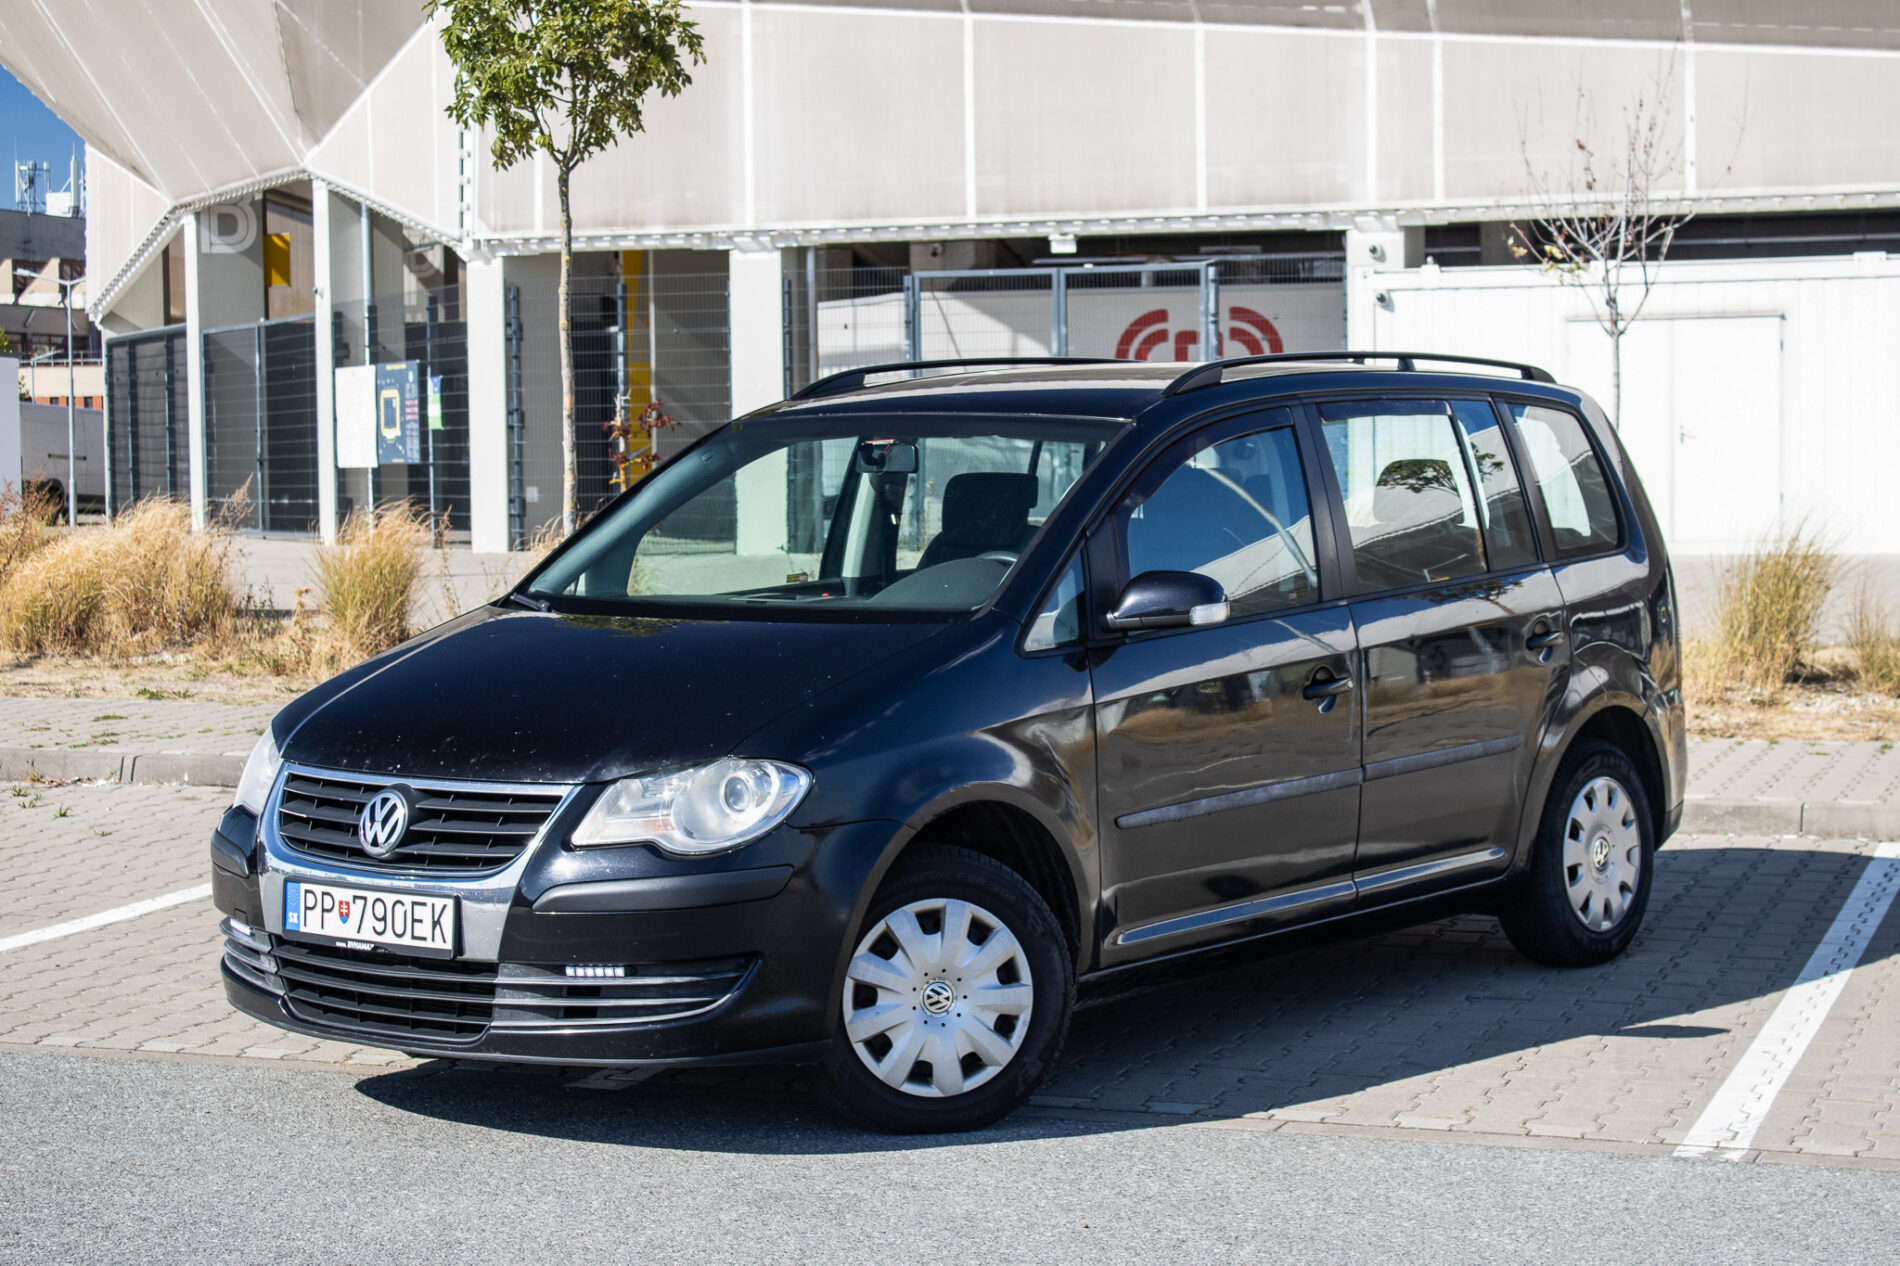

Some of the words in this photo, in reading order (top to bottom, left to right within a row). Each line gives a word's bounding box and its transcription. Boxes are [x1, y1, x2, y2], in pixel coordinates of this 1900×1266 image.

[287, 911, 299, 924] SK
[303, 888, 336, 930] PP
[352, 894, 448, 944] 790EK
